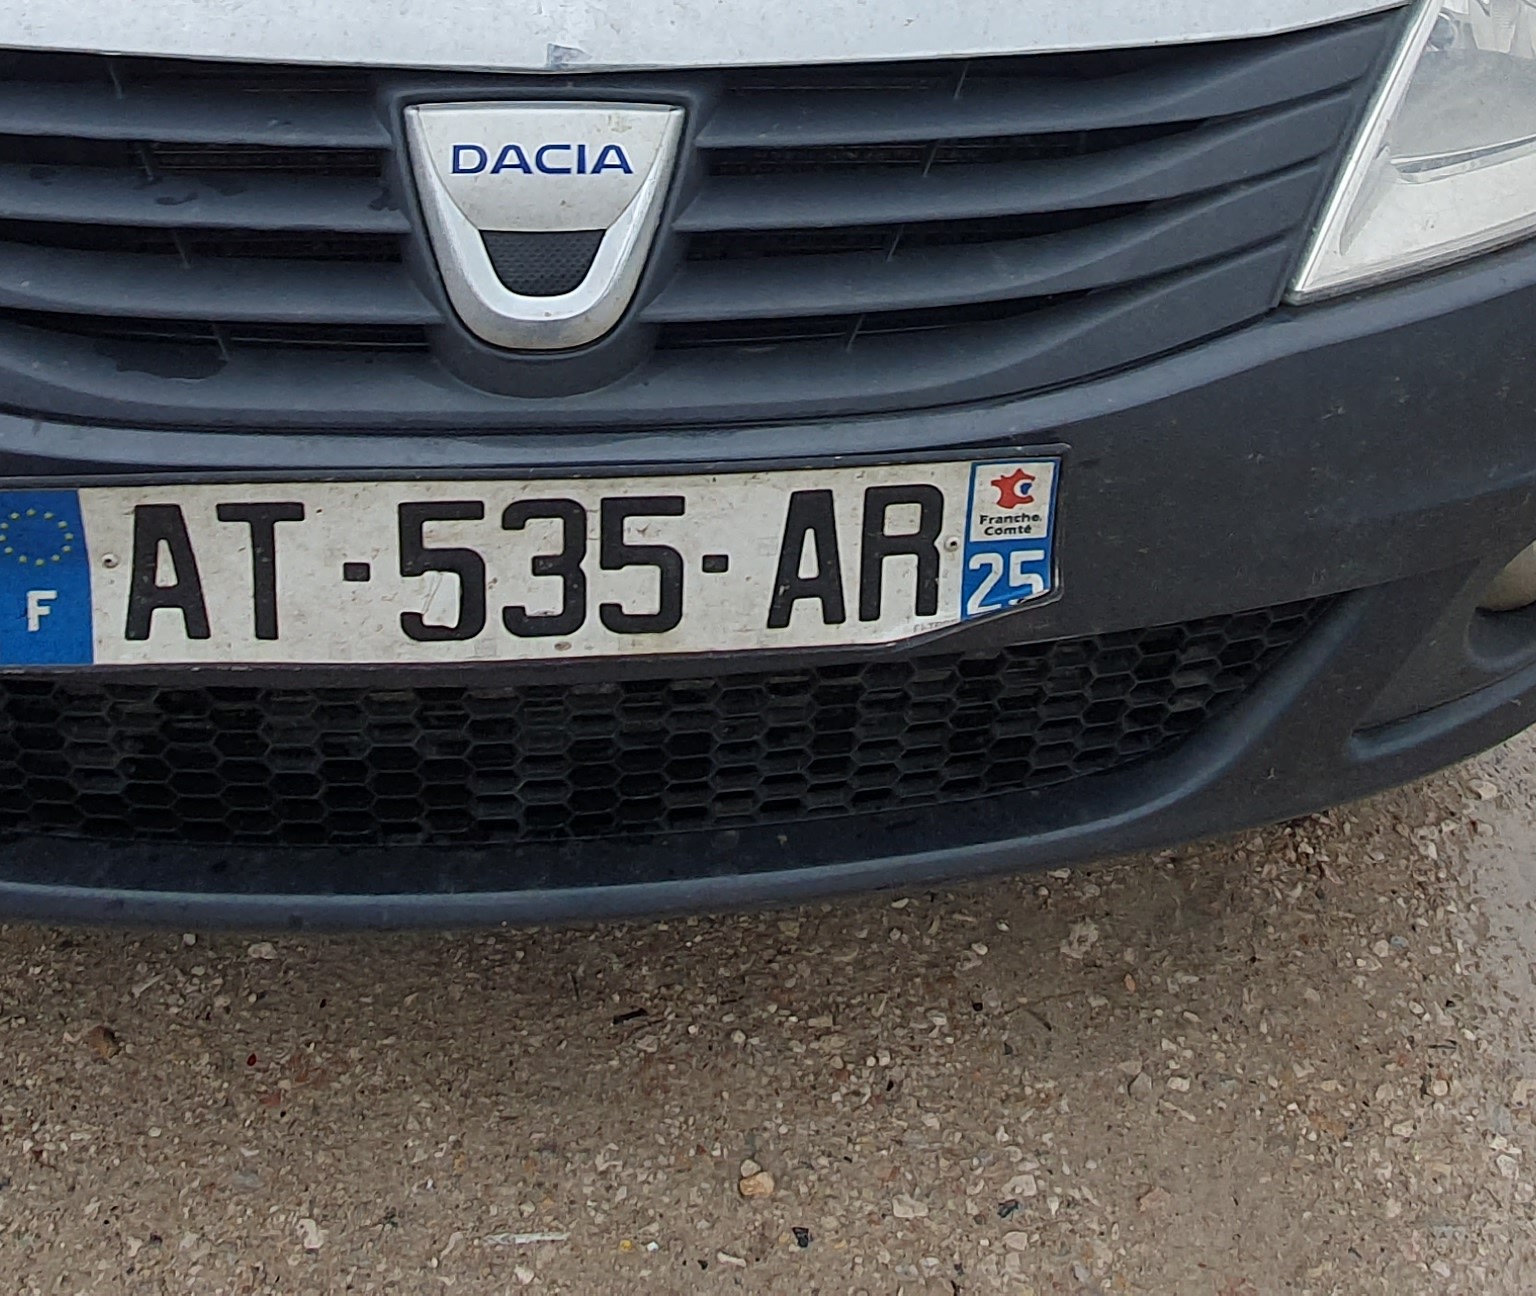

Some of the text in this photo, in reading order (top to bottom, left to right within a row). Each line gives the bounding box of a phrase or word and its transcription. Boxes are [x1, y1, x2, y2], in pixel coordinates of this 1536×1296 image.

[450, 143, 634, 175] DACIA
[984, 524, 1032, 536] Comté
[966, 549, 1045, 615] 25
[26, 590, 58, 632] F
